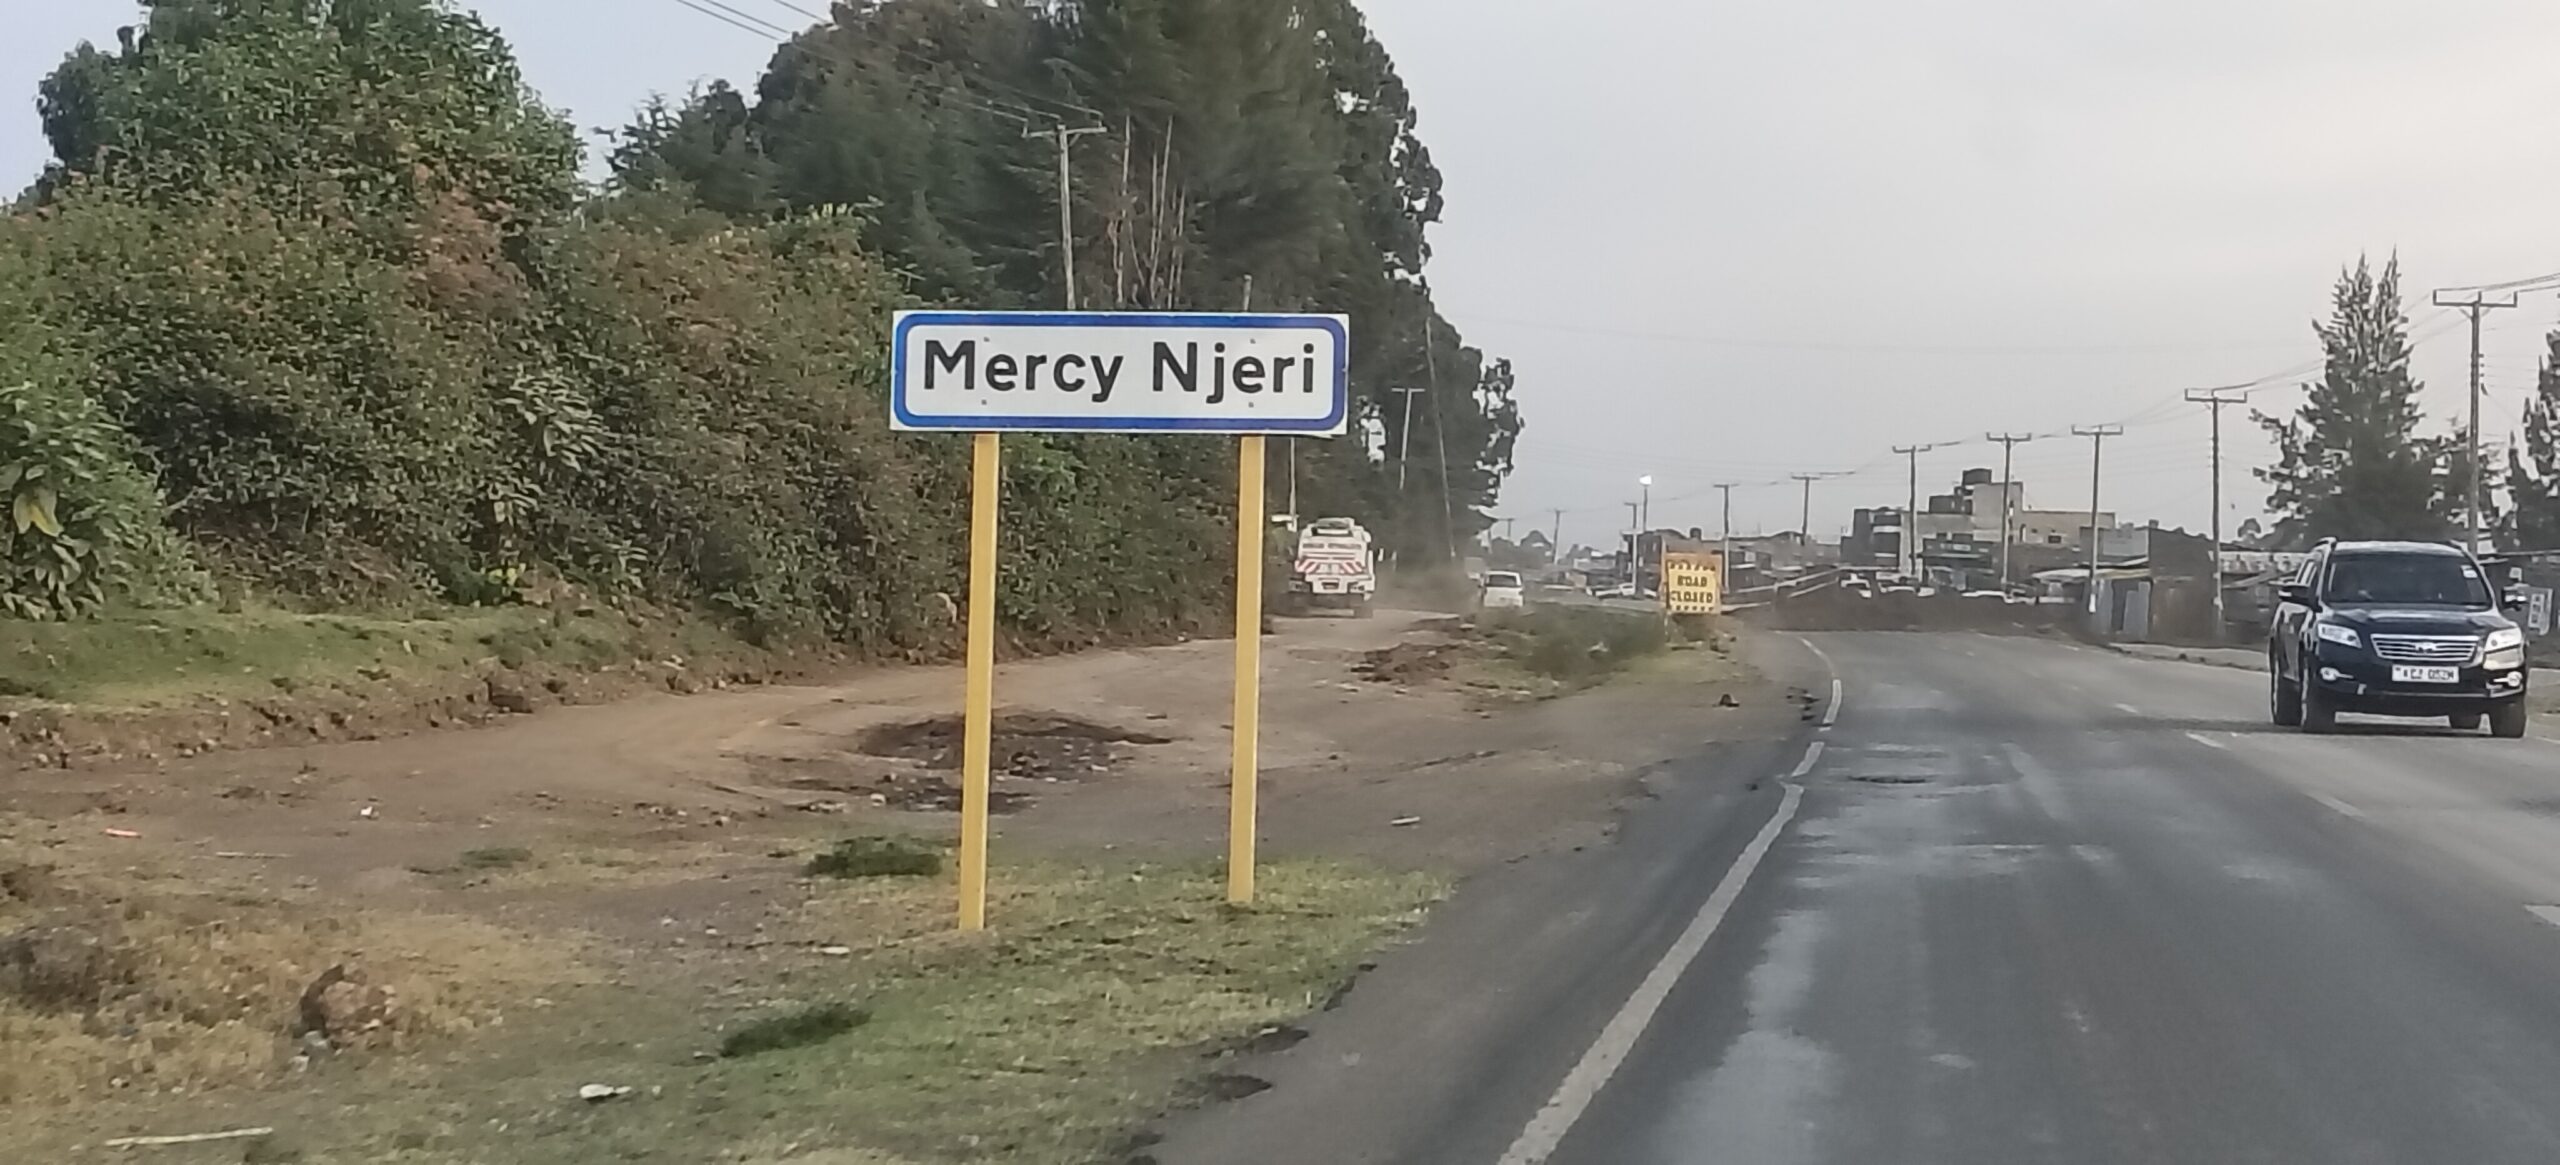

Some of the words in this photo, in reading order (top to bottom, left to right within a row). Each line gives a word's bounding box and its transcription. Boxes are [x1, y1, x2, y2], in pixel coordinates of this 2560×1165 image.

[924, 339, 1124, 402] Mercy
[1152, 341, 1315, 403] Njeri
[1677, 574, 1708, 587] ROAD
[1670, 590, 1713, 603] CLOSED
